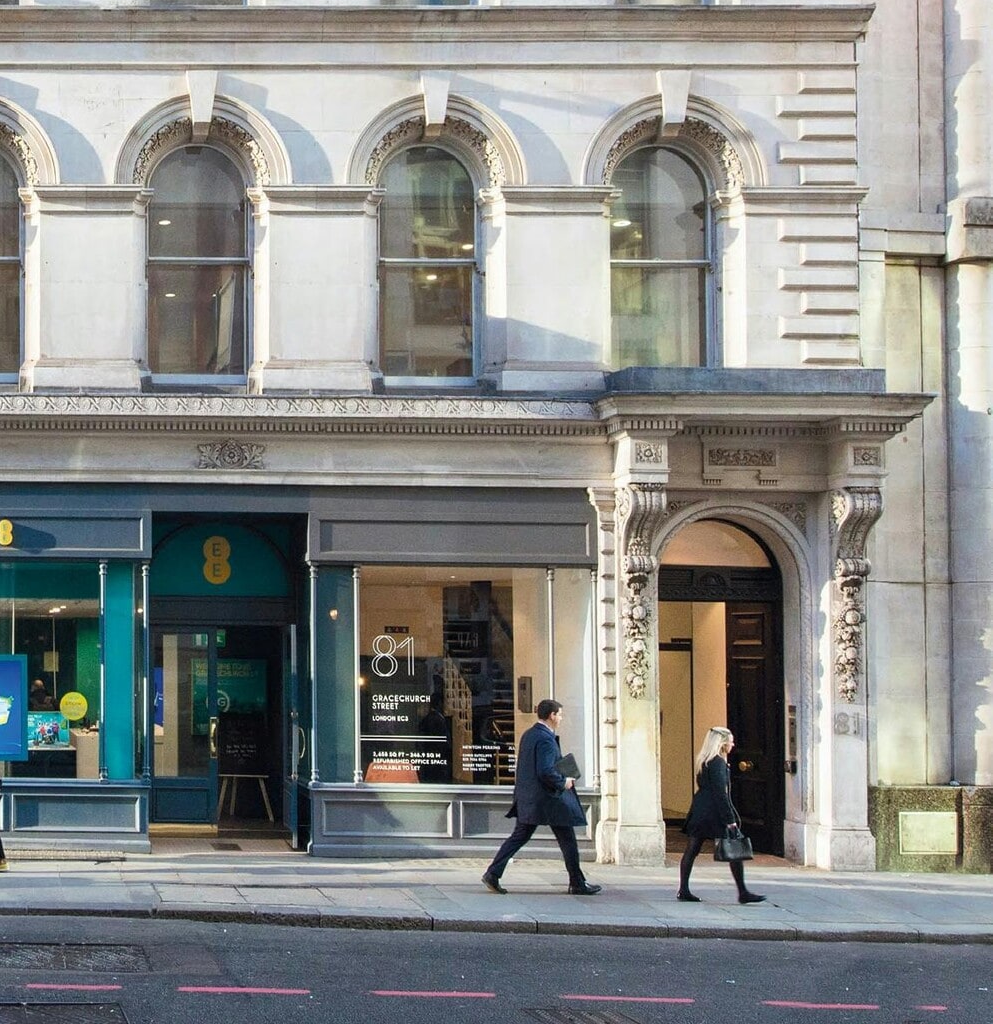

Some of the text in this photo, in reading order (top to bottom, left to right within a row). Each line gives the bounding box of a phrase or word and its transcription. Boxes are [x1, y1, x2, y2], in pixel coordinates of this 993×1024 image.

[371, 634, 415, 677] 81
[372, 694, 431, 703] GRACECHURCH
[372, 702, 399, 710] STREET
